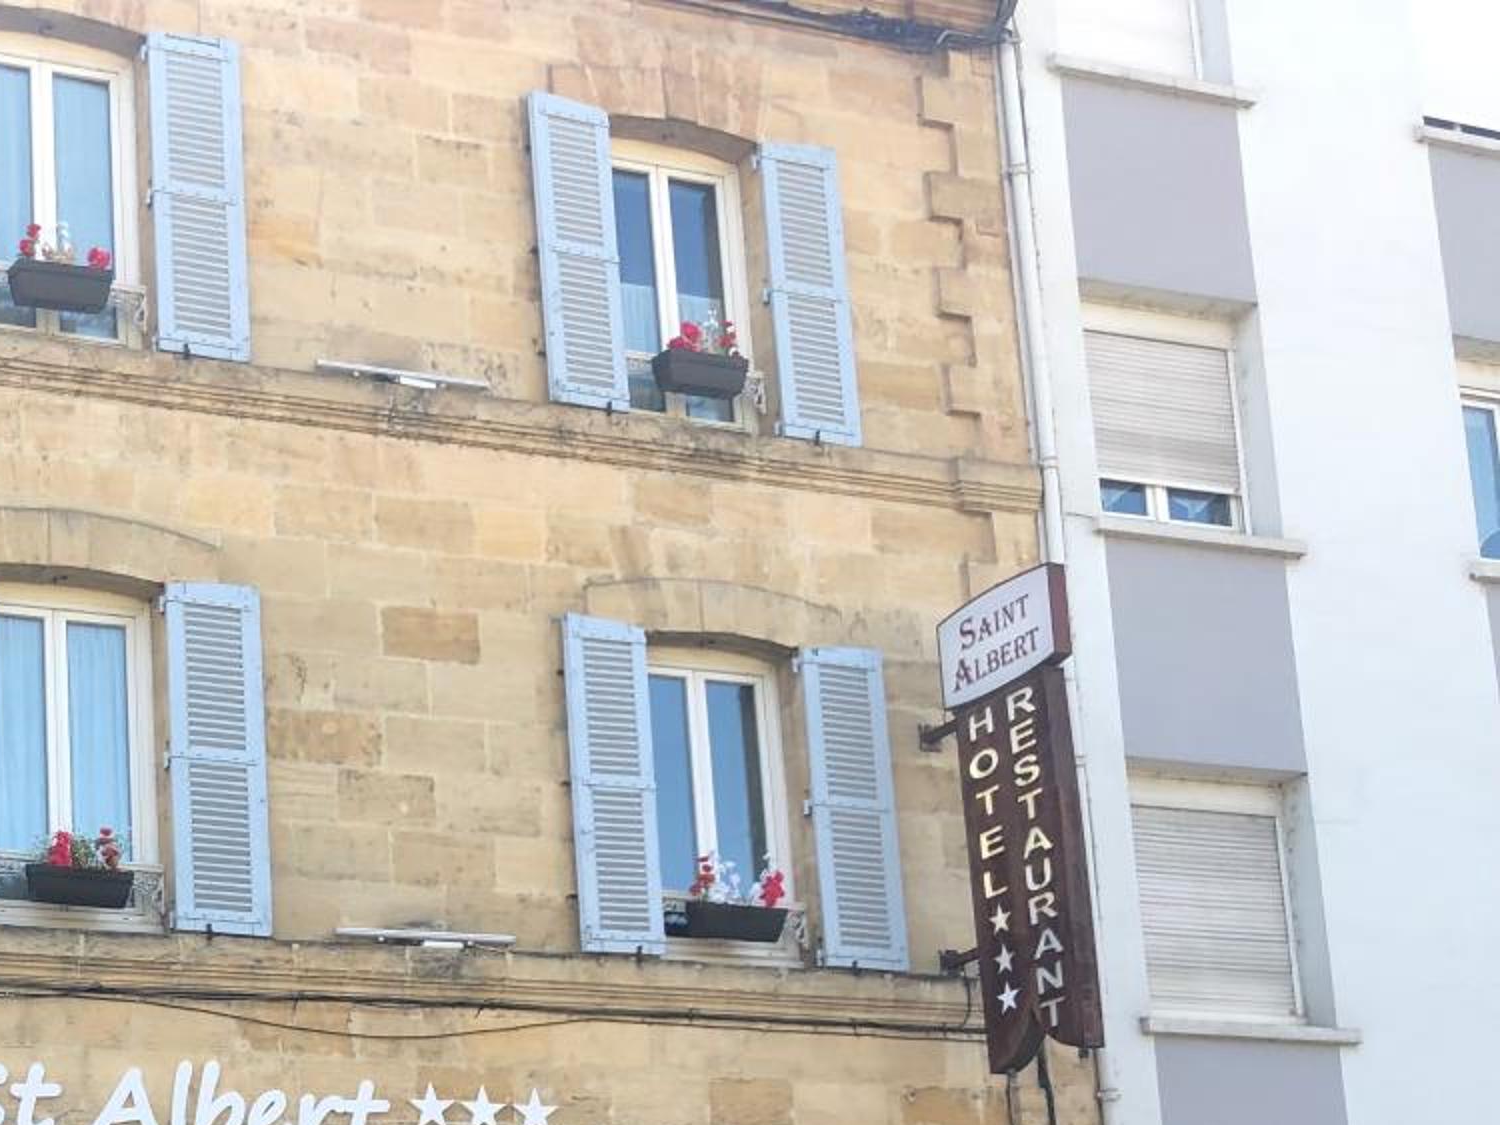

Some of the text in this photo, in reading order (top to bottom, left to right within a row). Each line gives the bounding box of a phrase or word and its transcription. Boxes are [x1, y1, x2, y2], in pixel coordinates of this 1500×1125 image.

[953, 627, 1039, 692] ALBERT
[959, 594, 1029, 650] SAINT
[969, 707, 1008, 899] HOTEL
[1006, 686, 1065, 1028] RESTAURANT
